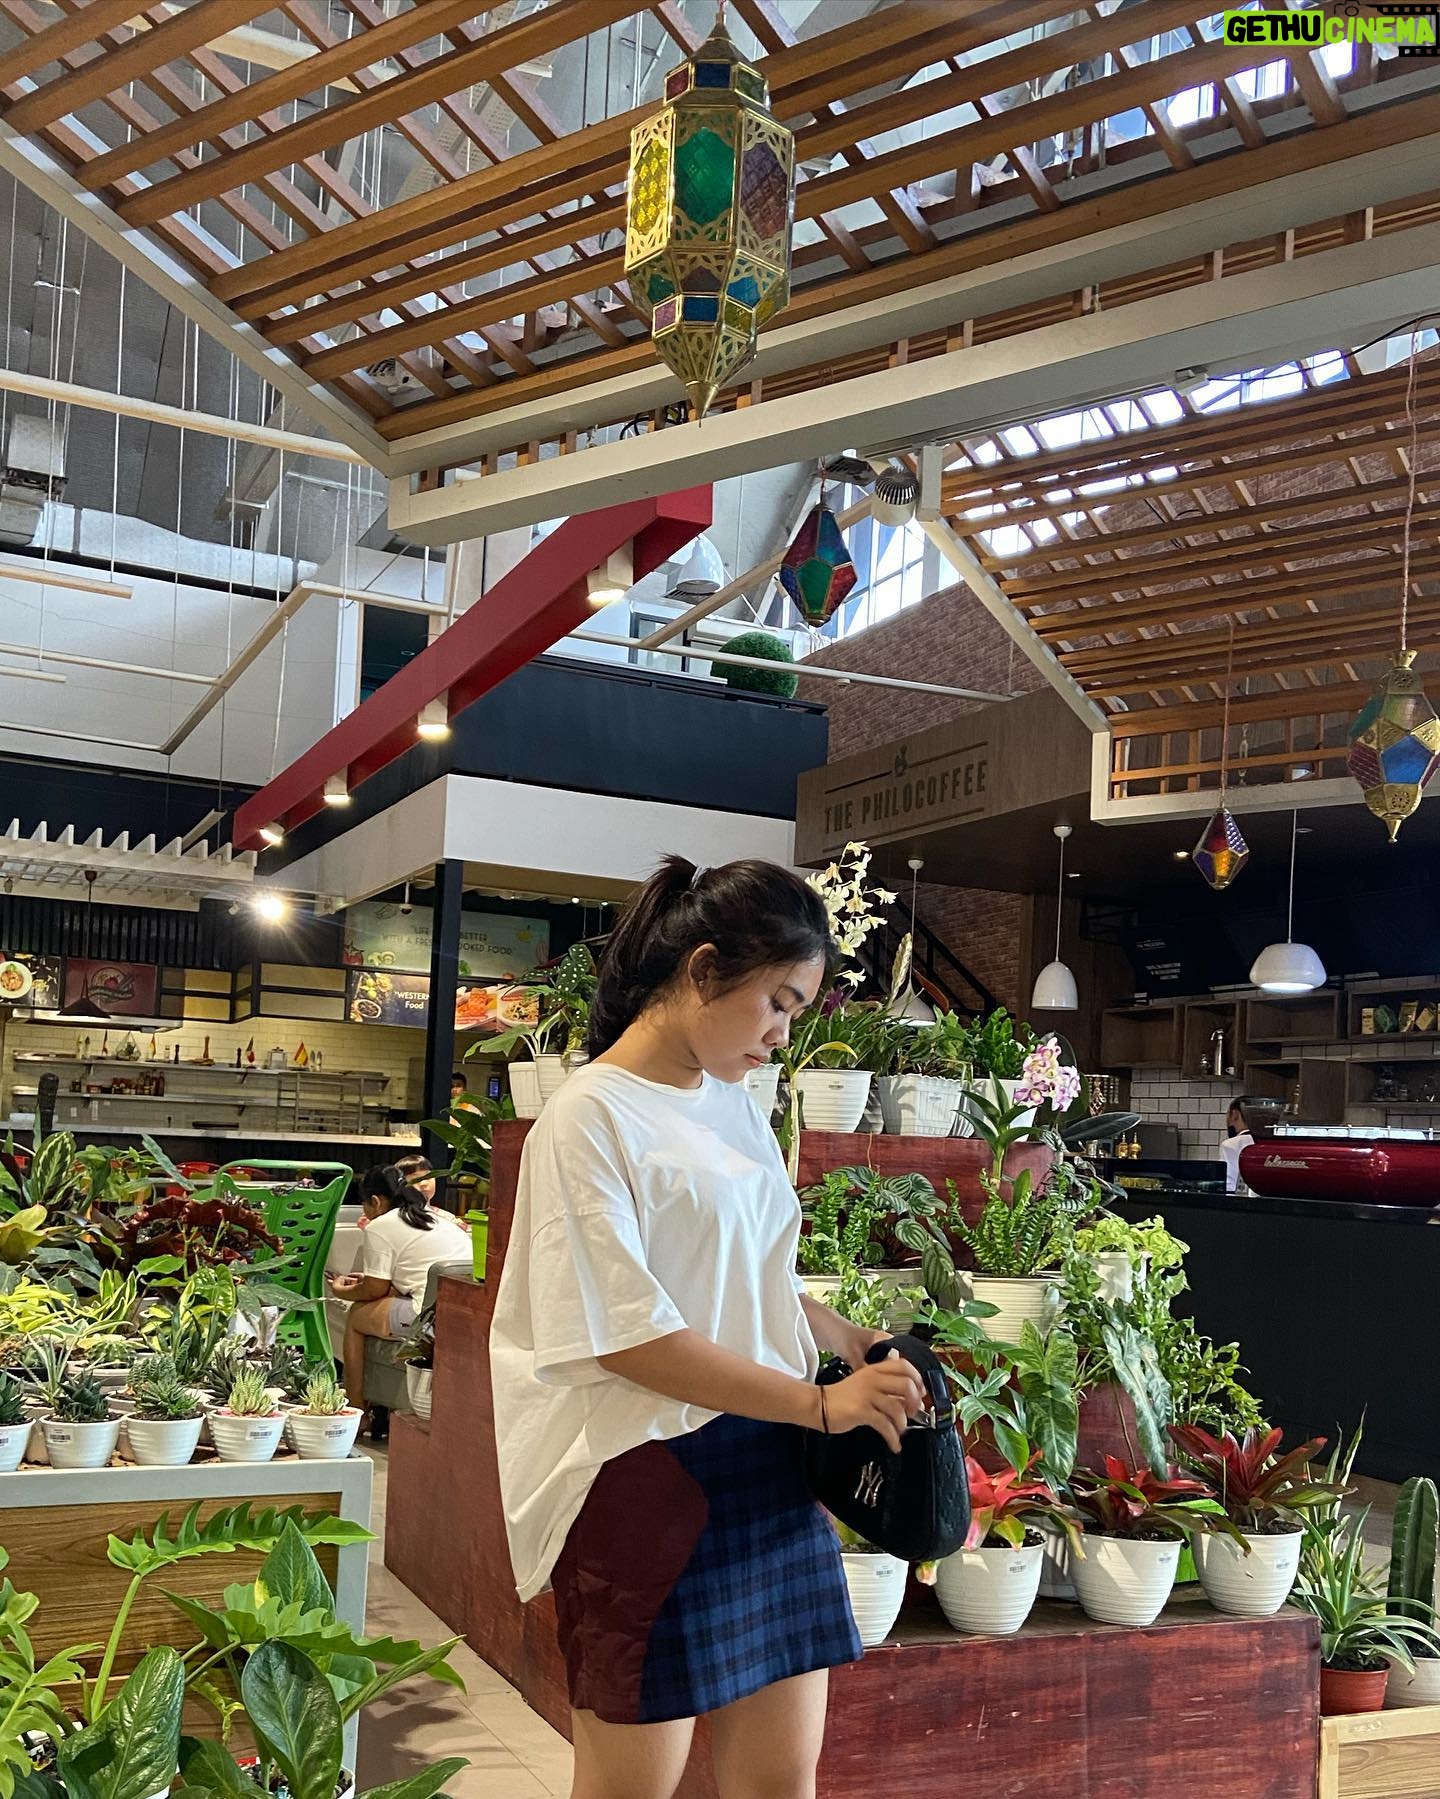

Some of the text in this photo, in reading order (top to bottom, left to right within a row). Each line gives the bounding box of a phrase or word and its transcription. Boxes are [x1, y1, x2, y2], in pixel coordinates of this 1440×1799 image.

[824, 760, 988, 834] THE PHILOCOFFEE
[405, 1000, 424, 1009] Food
